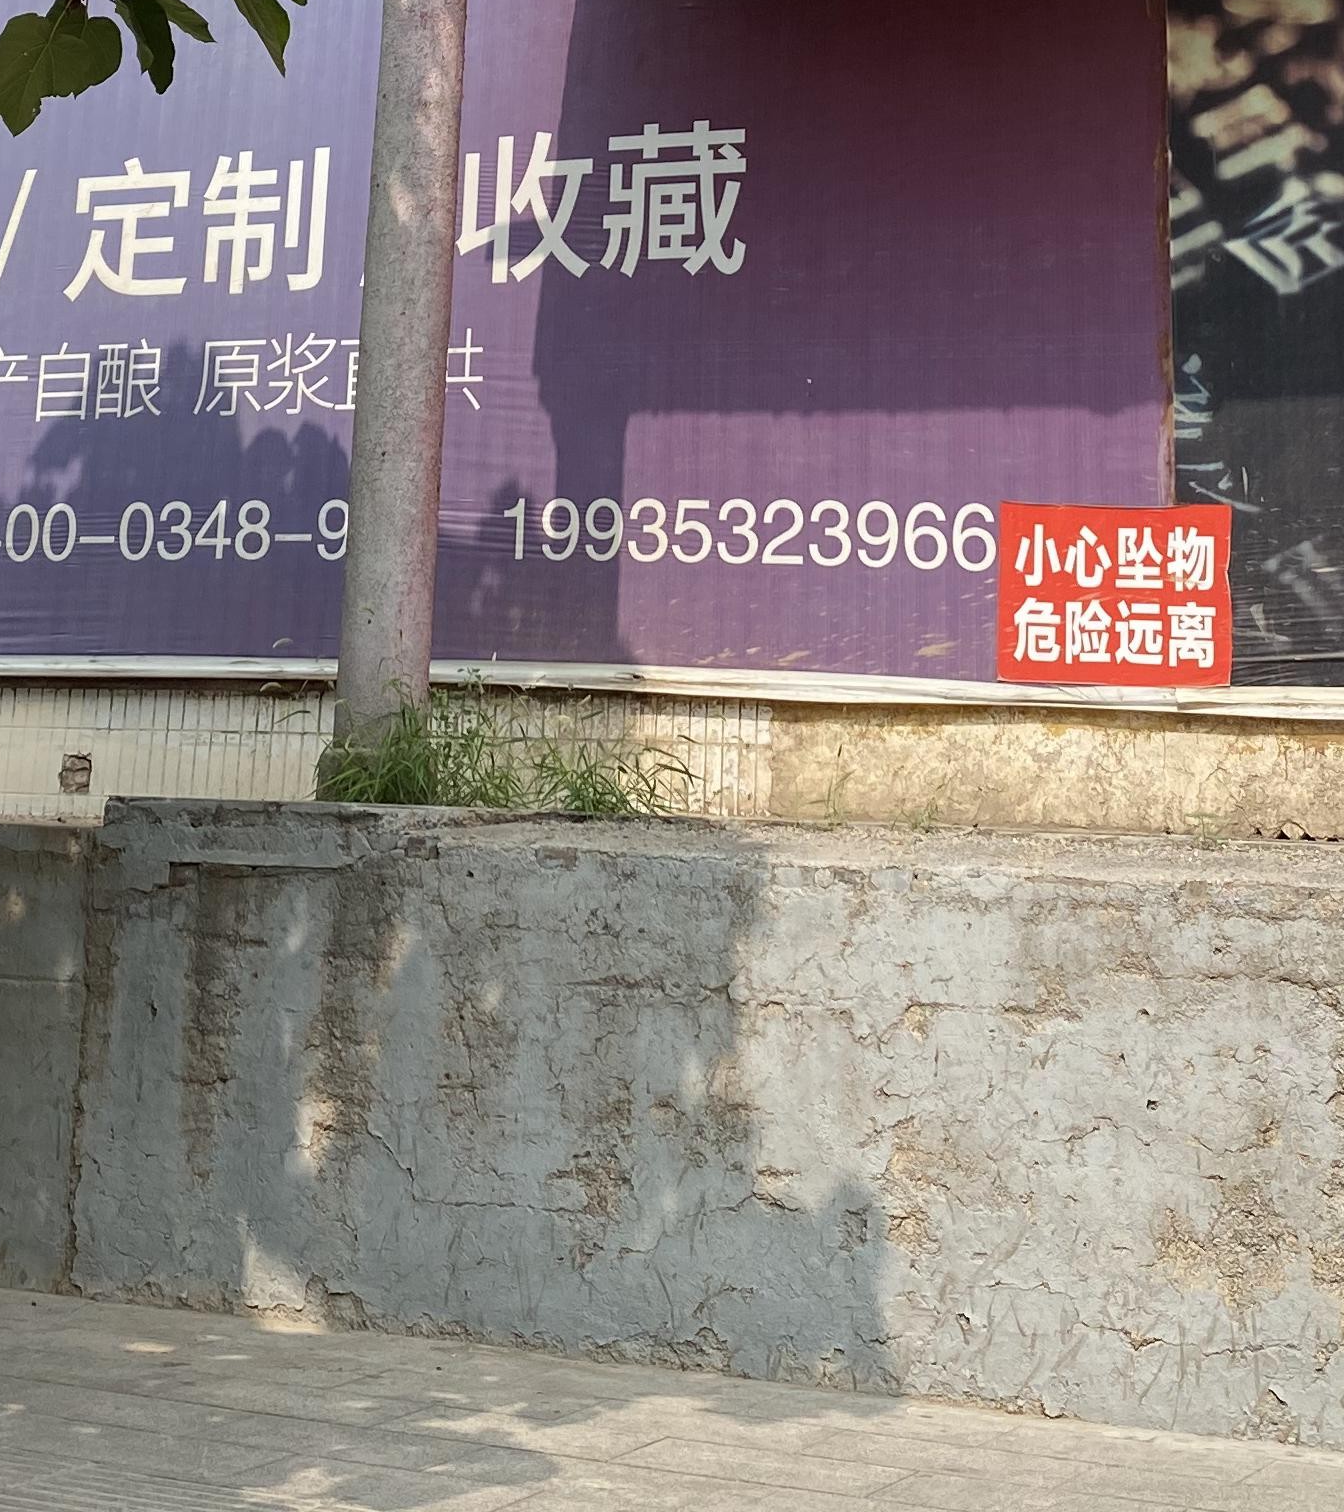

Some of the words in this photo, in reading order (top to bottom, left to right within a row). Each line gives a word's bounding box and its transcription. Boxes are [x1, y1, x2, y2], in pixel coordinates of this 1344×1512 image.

[456, 119, 748, 284] 收藏
[503, 497, 997, 572] 19935323966
[1014, 524, 1215, 592] 小心坠物
[1013, 596, 1217, 668] 危险远离
